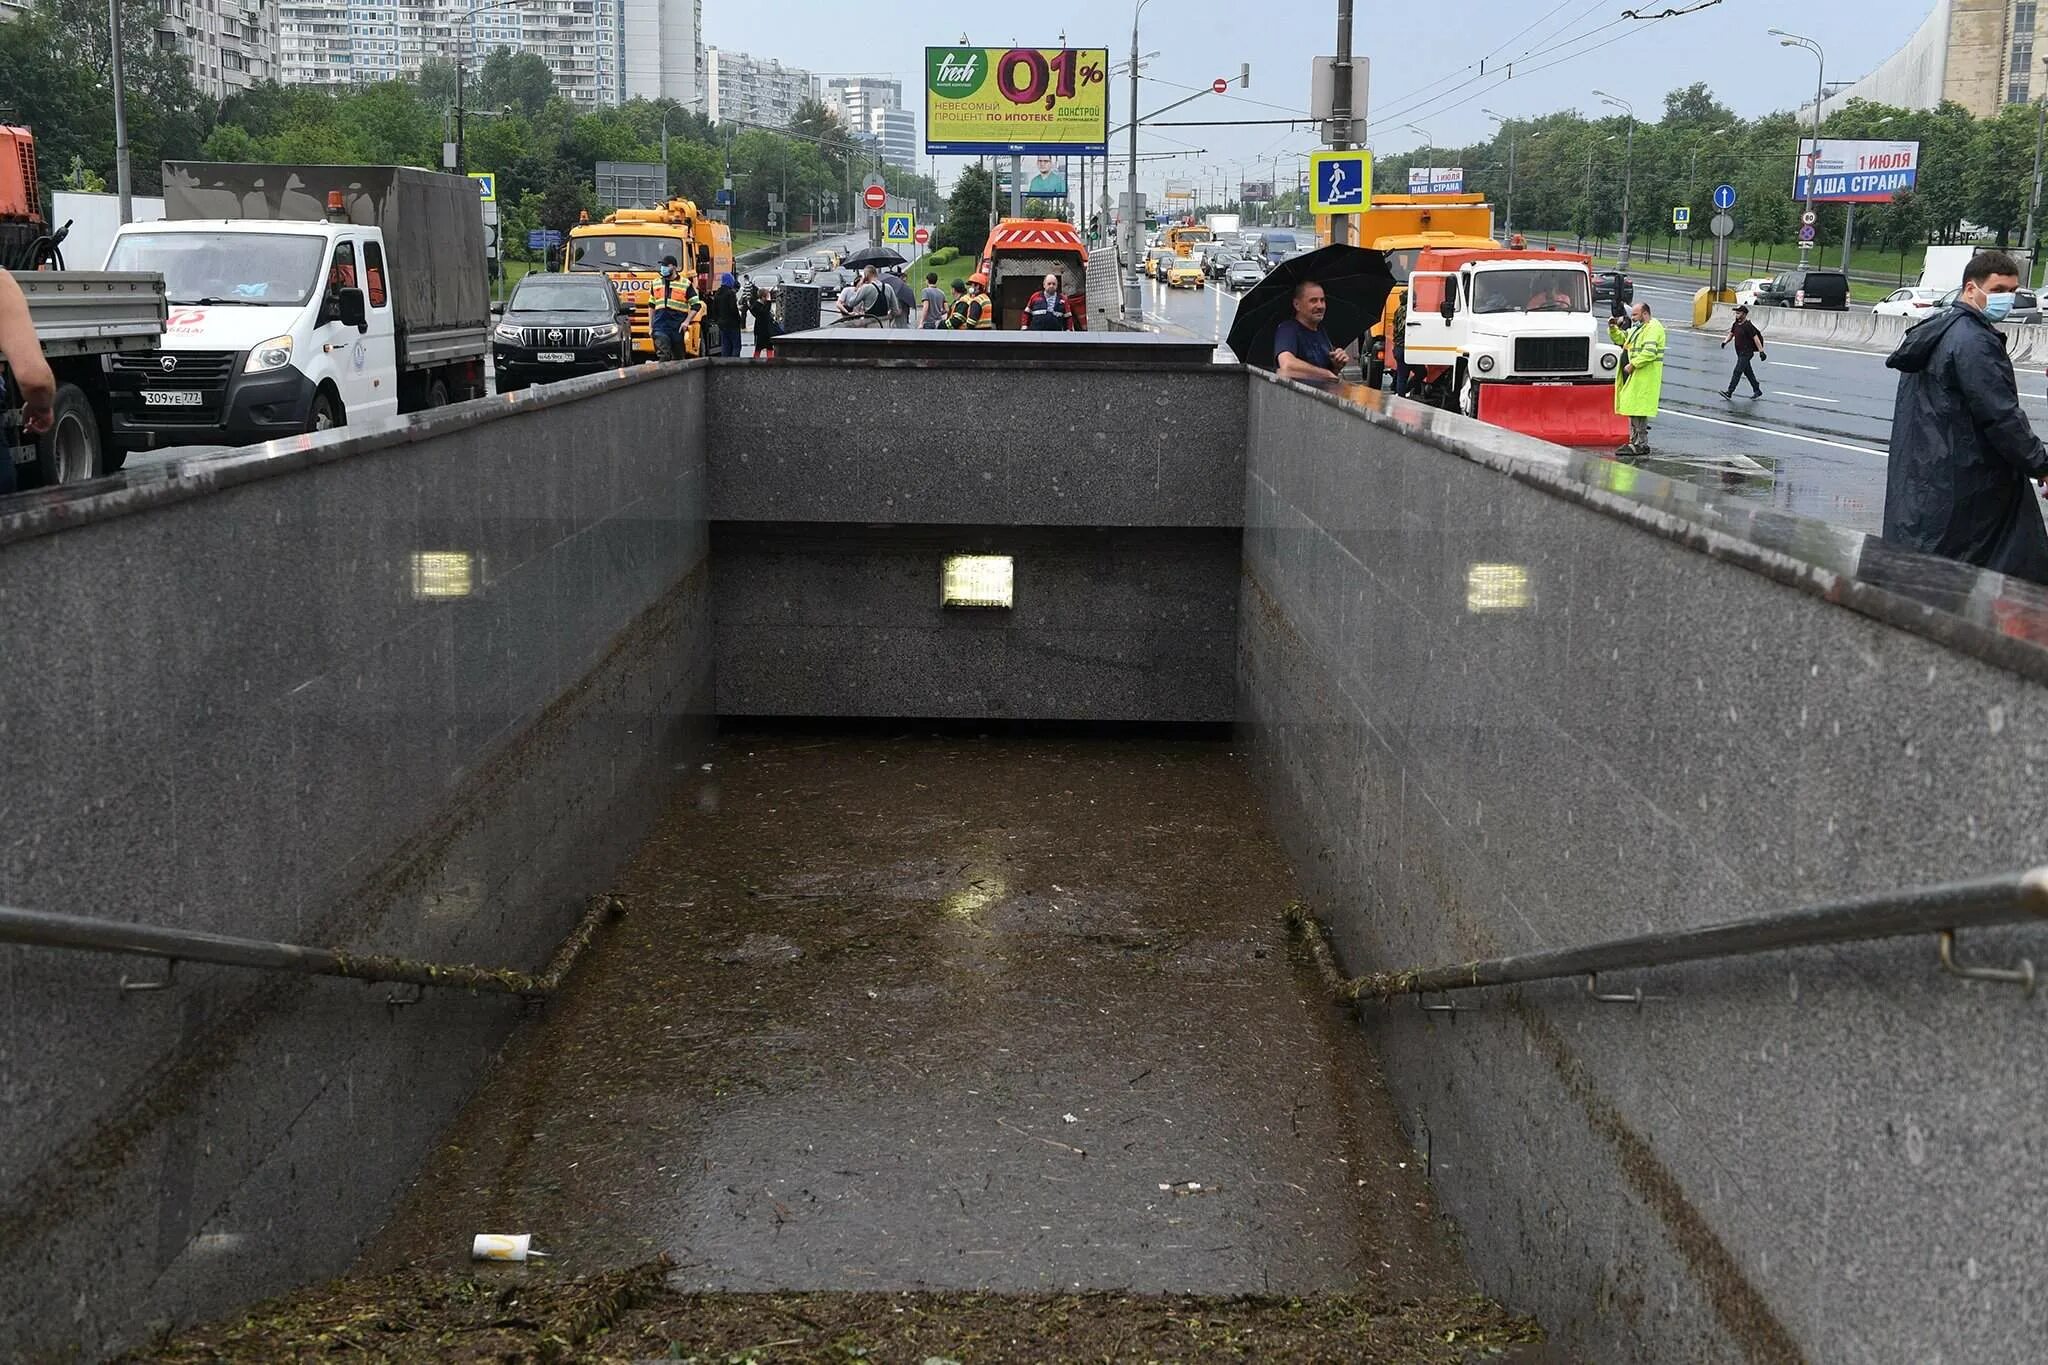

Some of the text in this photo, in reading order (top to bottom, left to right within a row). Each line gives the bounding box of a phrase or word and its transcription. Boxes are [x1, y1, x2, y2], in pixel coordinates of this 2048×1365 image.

[936, 53, 979, 82] fresh
[934, 102, 1001, 111] НЕВЕСОМЫЙ
[1058, 105, 1100, 117] ДОНСТРОЙ
[934, 112, 1054, 122] ПРОЦЕНТ ПО ИПОТЕКЕ
[1860, 156, 1865, 170] 1
[1868, 152, 1911, 170] ИЮЛЯ
[1433, 182, 1460, 192] СТРАНА
[1851, 173, 1907, 193] СТРАНА
